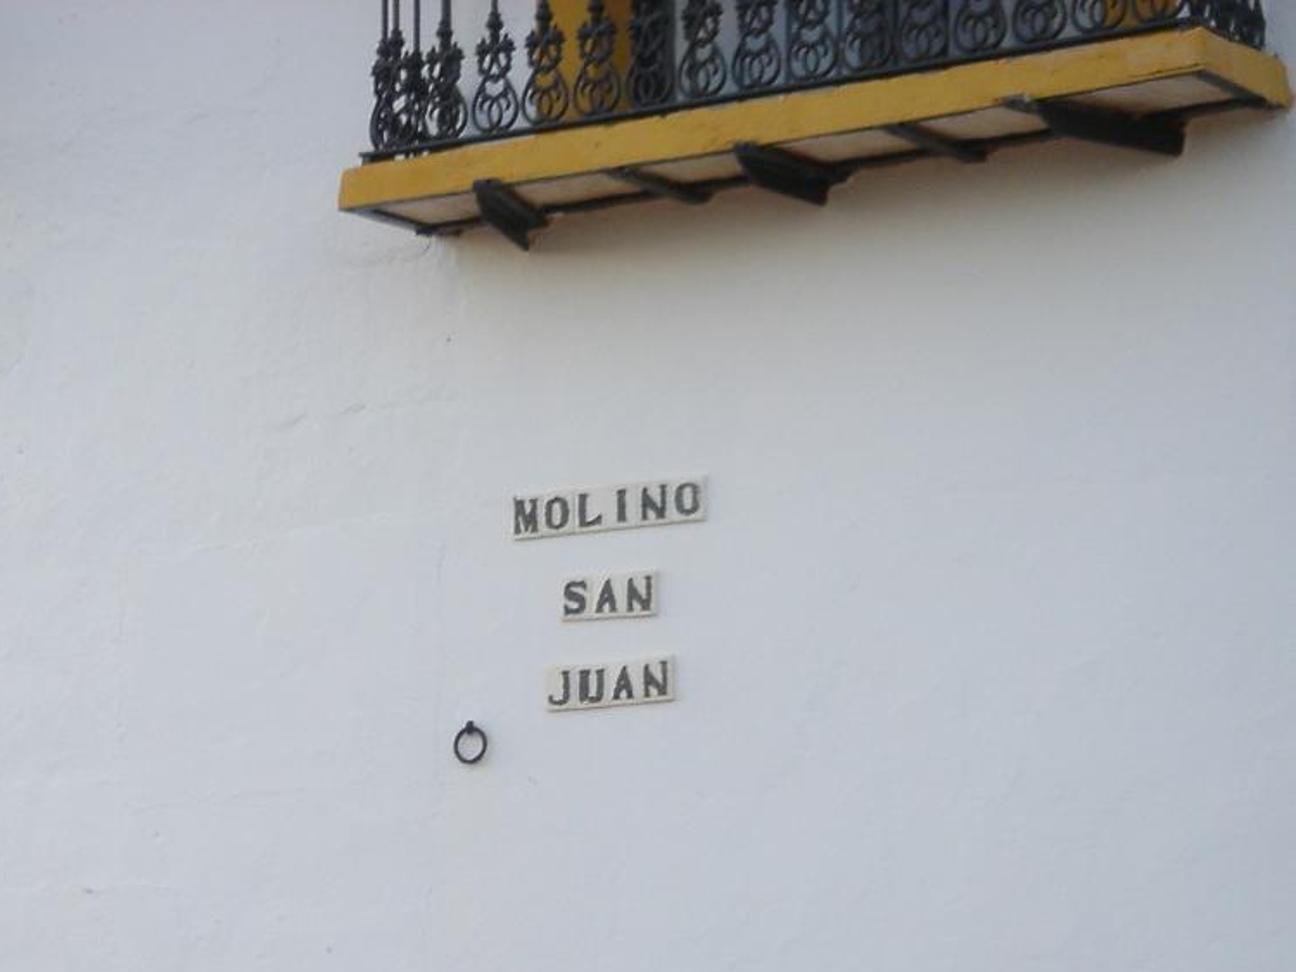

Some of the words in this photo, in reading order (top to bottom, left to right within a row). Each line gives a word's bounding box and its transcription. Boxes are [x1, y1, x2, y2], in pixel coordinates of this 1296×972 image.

[513, 482, 701, 535] MOLINO
[563, 575, 653, 616] SAN
[547, 660, 669, 706] JUAN
